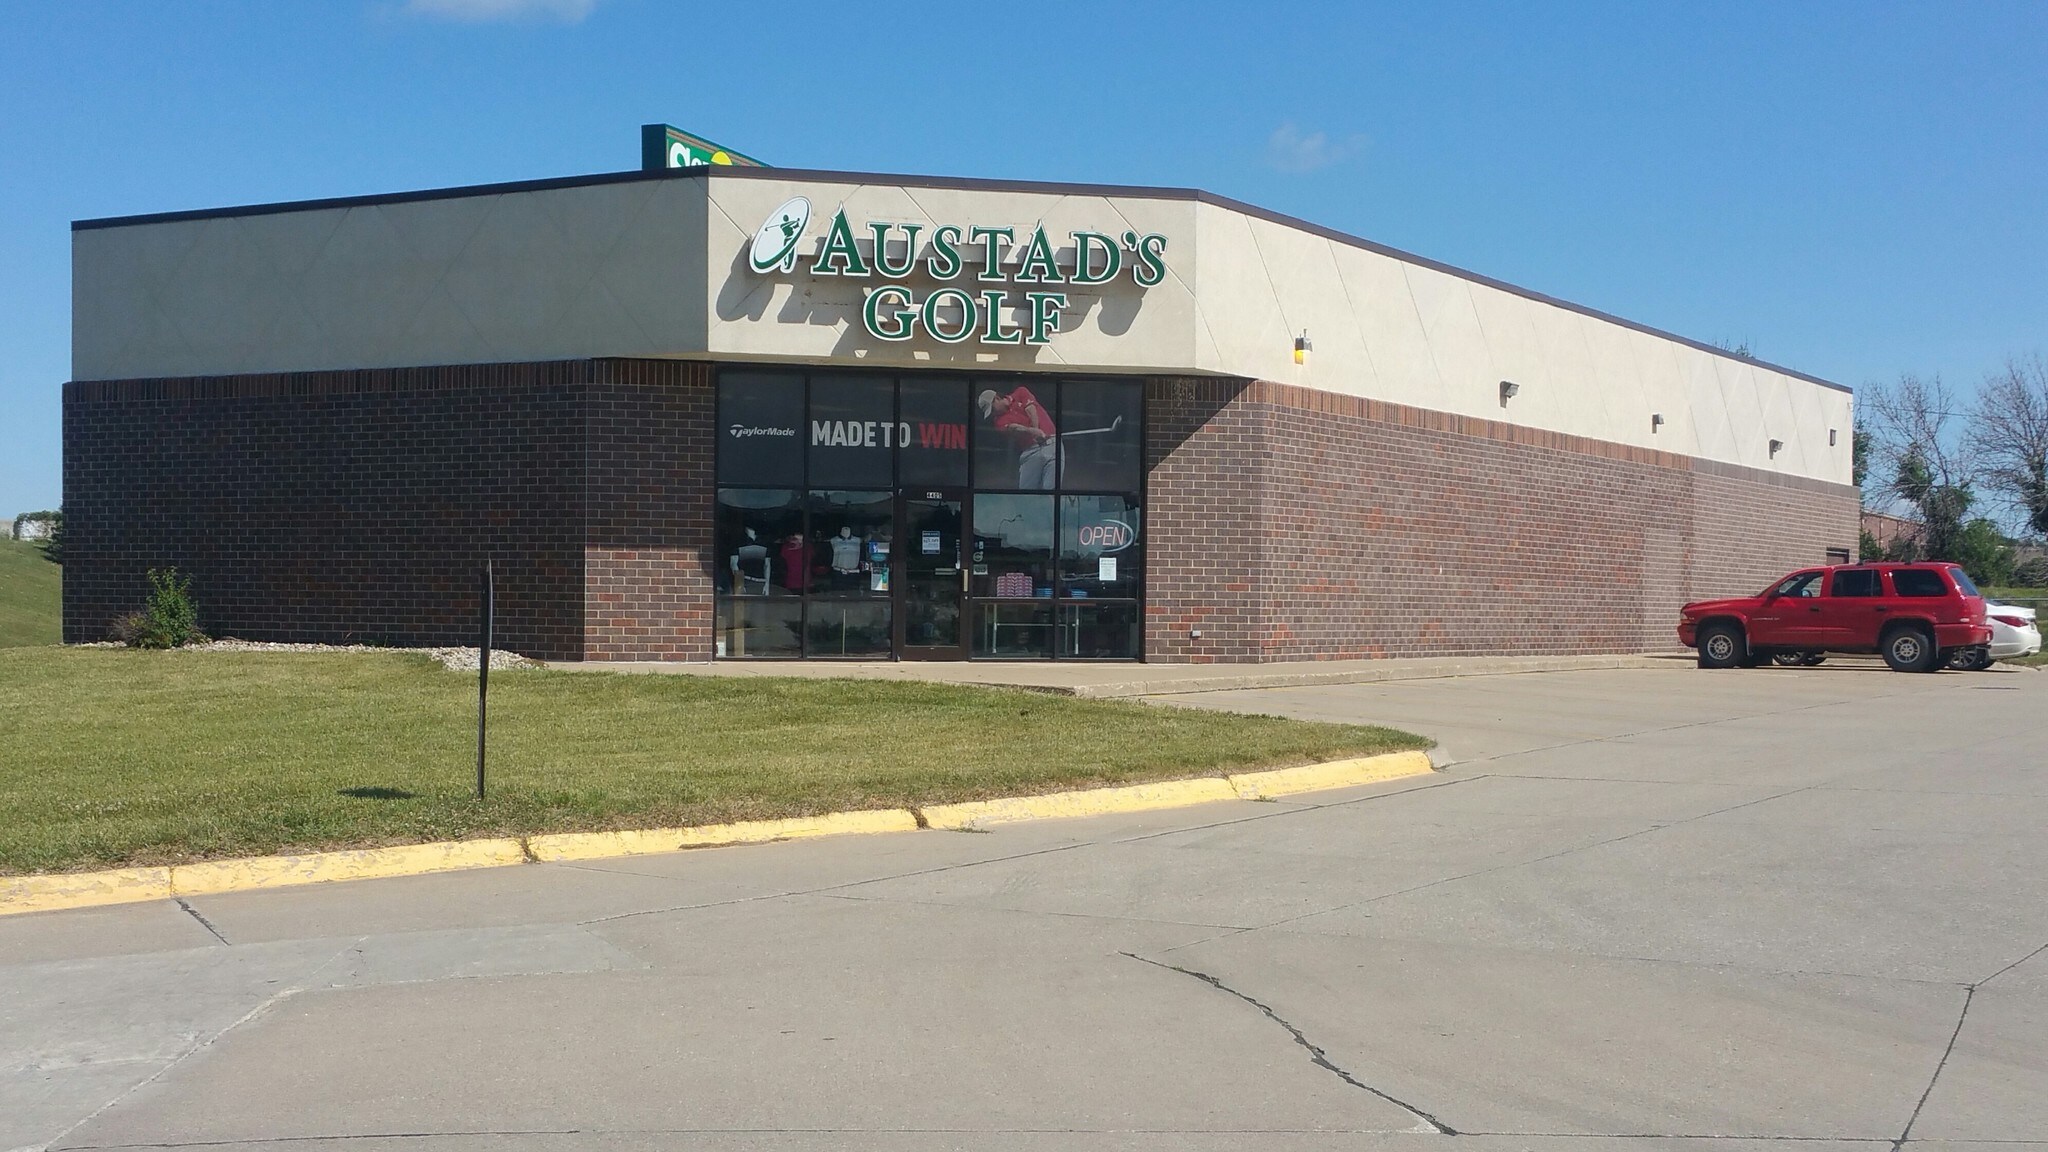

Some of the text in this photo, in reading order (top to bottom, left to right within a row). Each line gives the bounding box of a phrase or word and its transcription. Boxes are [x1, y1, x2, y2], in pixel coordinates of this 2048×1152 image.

[810, 201, 1168, 288] AUSTAD'S
[862, 285, 1067, 345] GOLF
[729, 424, 795, 438] TaylorMade
[812, 420, 967, 449] MADE TO WIN
[1079, 526, 1125, 546] OPEN
